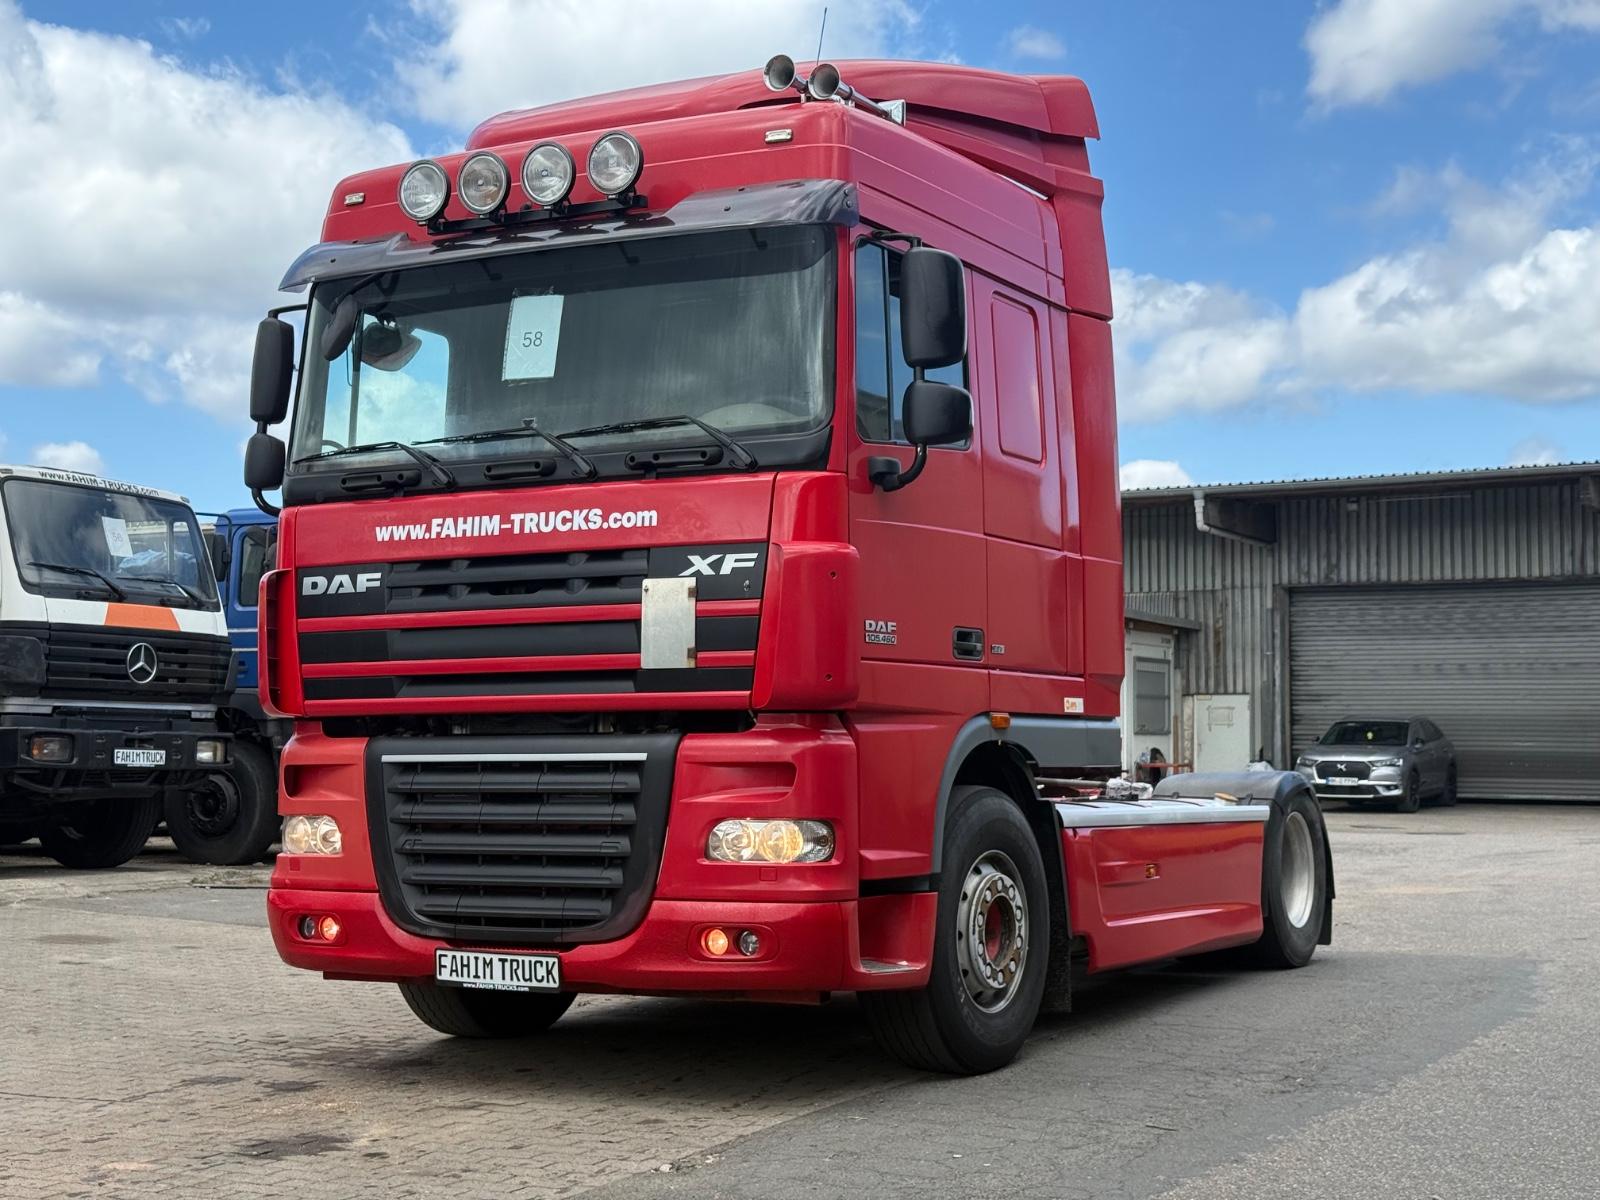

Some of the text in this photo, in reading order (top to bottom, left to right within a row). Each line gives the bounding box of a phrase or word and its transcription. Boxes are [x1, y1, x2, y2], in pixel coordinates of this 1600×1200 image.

[522, 330, 543, 348] 58
[38, 470, 160, 497] www.FAHIM-TRUCKS.com
[375, 508, 658, 542] www.FAHIM-TRUCKS.com
[678, 552, 759, 576] XF
[302, 572, 382, 596] DAF
[865, 619, 897, 633] DAF
[438, 953, 558, 985] FAHIM TRUCK
